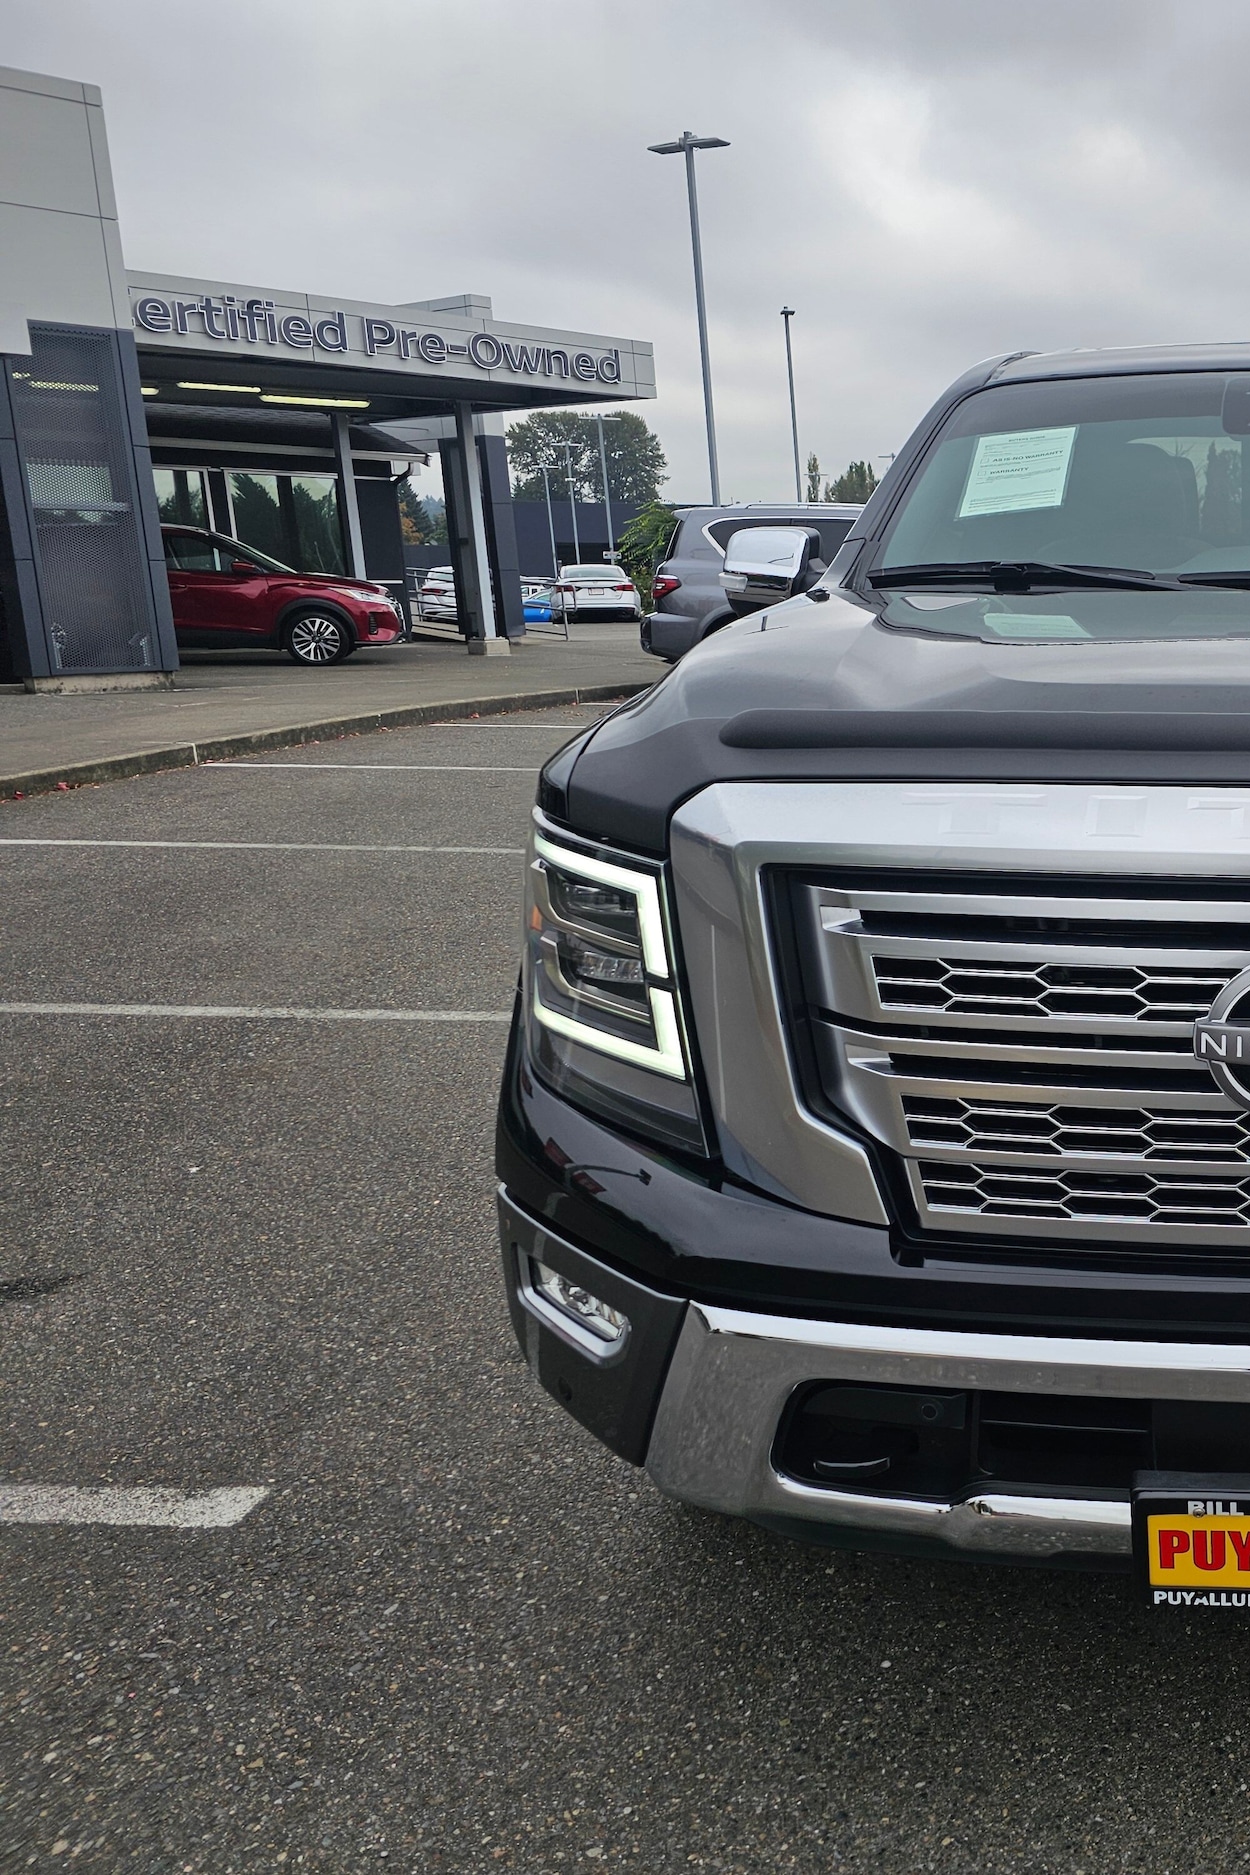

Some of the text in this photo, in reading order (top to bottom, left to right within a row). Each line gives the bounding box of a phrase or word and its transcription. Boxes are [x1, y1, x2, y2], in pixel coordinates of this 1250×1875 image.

[128, 295, 624, 386] ertified Pre-Owned
[1025, 450, 1064, 460] WARRANTY
[989, 466, 1030, 475] WARRANTY
[1187, 1500, 1245, 1517] BILL
